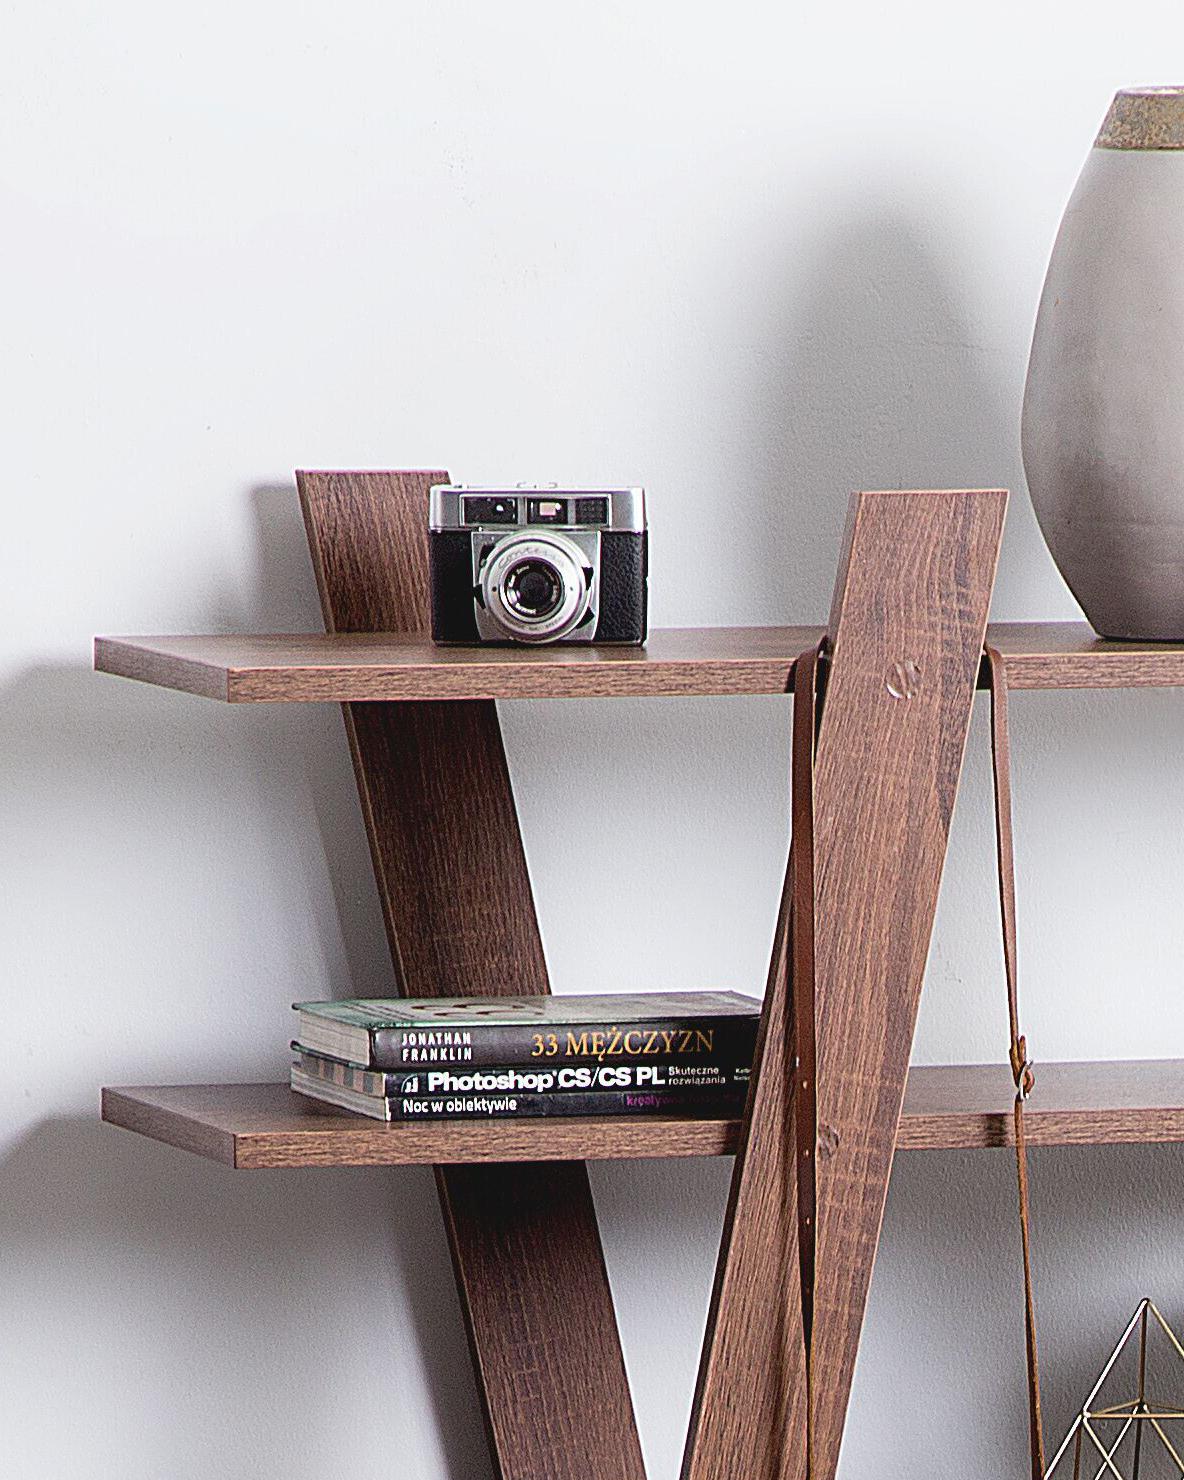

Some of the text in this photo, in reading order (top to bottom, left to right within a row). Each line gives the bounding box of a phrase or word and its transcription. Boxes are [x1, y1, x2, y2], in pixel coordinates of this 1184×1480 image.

[402, 1032, 471, 1046] JONATHAN
[531, 1026, 715, 1062] 33 MĘŻCZYZN
[402, 1047, 472, 1062] FRANKLIN
[668, 1065, 720, 1076] Skuteczne
[428, 1066, 665, 1093] Photoshop CS/CS PL
[668, 1076, 726, 1087] rozwiązania
[403, 1097, 518, 1115] Noc w obiektywie
